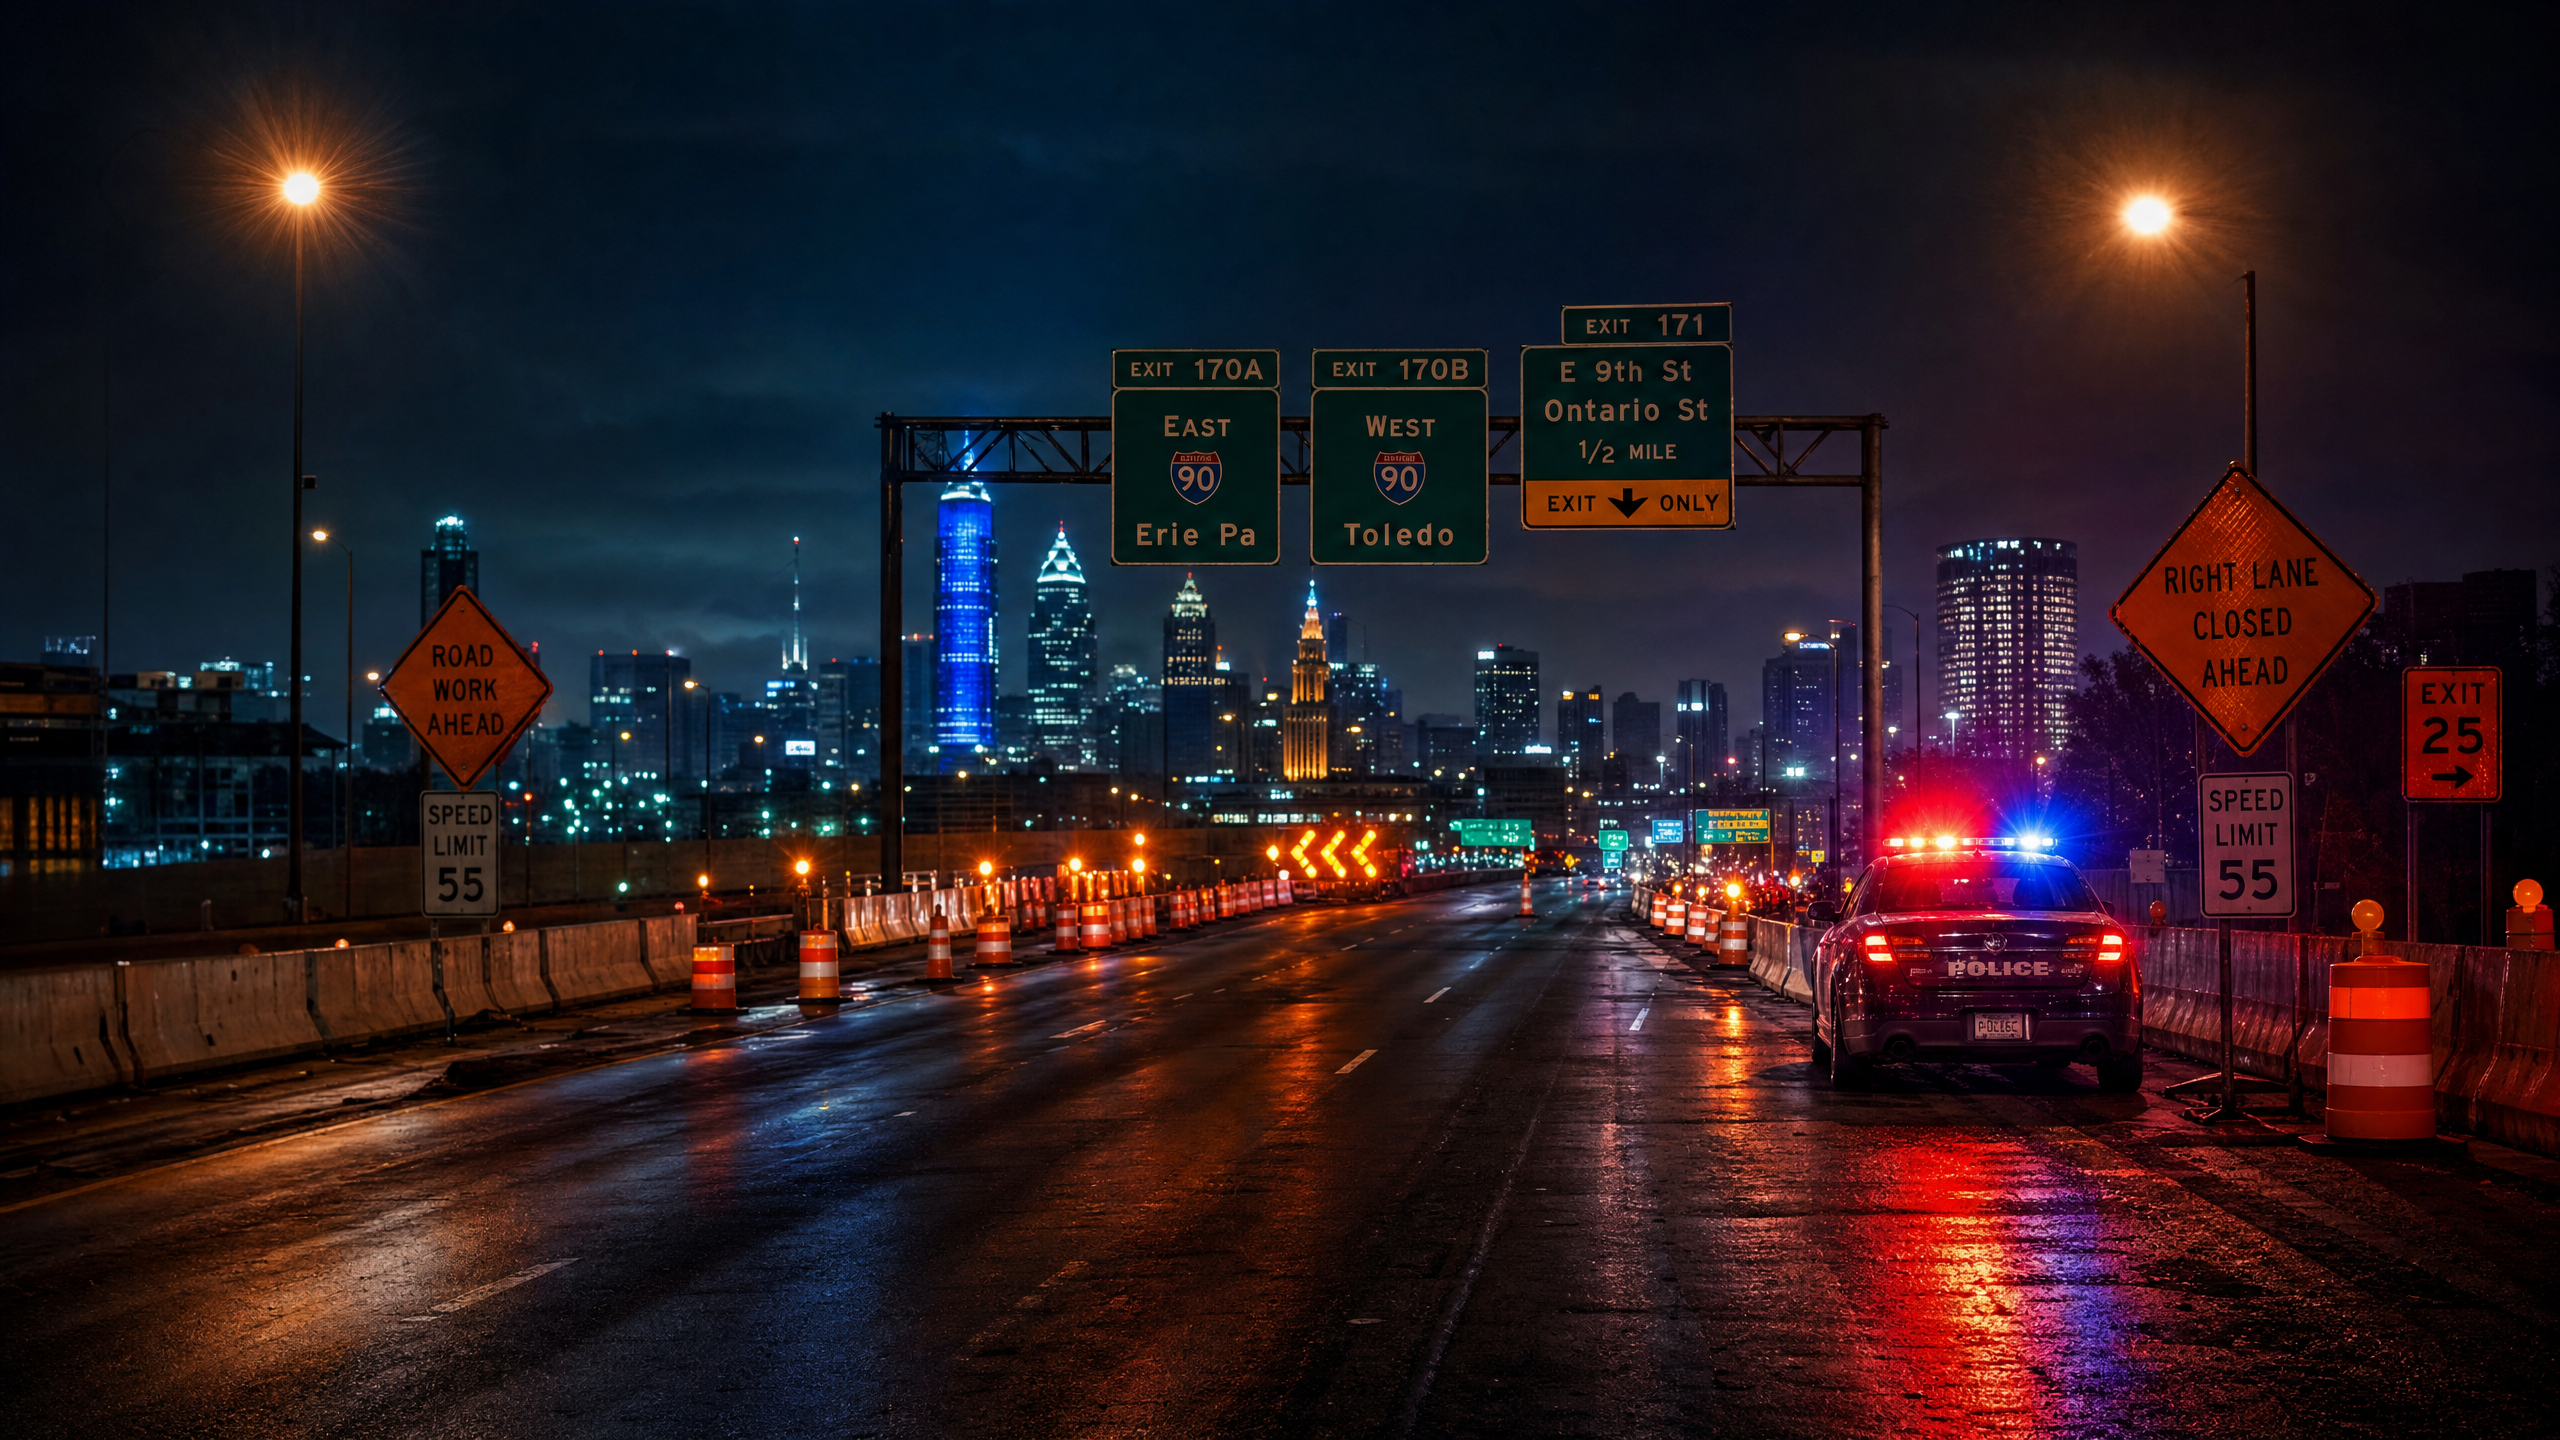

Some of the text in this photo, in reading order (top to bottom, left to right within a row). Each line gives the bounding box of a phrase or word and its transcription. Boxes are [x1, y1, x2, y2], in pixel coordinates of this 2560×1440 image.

[1586, 313, 1703, 336] EXIT 171
[1130, 358, 1264, 380] EXIT 170A
[1332, 358, 1469, 381] EXIT 170B
[1560, 359, 1692, 383] E 9th St
[1544, 397, 1708, 422] Ontario St
[1164, 415, 1231, 437] EAST
[1365, 415, 1436, 437] WEST
[1578, 439, 1677, 465] 1/2 MILE
[1178, 465, 1215, 492] 90
[1381, 465, 1418, 492] 90
[1547, 493, 1720, 512] EXIT ONLY
[1136, 522, 1256, 546] Erie Pa
[1343, 522, 1454, 546] Toledo
[2164, 556, 2319, 595] RIGHT LANE
[2193, 606, 2292, 641] CLOSED
[432, 644, 494, 668] ROAD
[2201, 655, 2289, 689] AHEAD
[432, 678, 498, 702] WORK
[2421, 682, 2486, 705] EXIT
[426, 712, 504, 736] AHEAD
[2421, 716, 2484, 755] 25
[2208, 788, 2284, 813] SPEED
[428, 804, 493, 826] SPEED
[434, 834, 488, 857] LIMIT
[2215, 822, 2278, 847] LIMIT
[438, 866, 484, 903] 55
[2218, 858, 2278, 901] 55
[1947, 961, 2049, 976] POLICE
